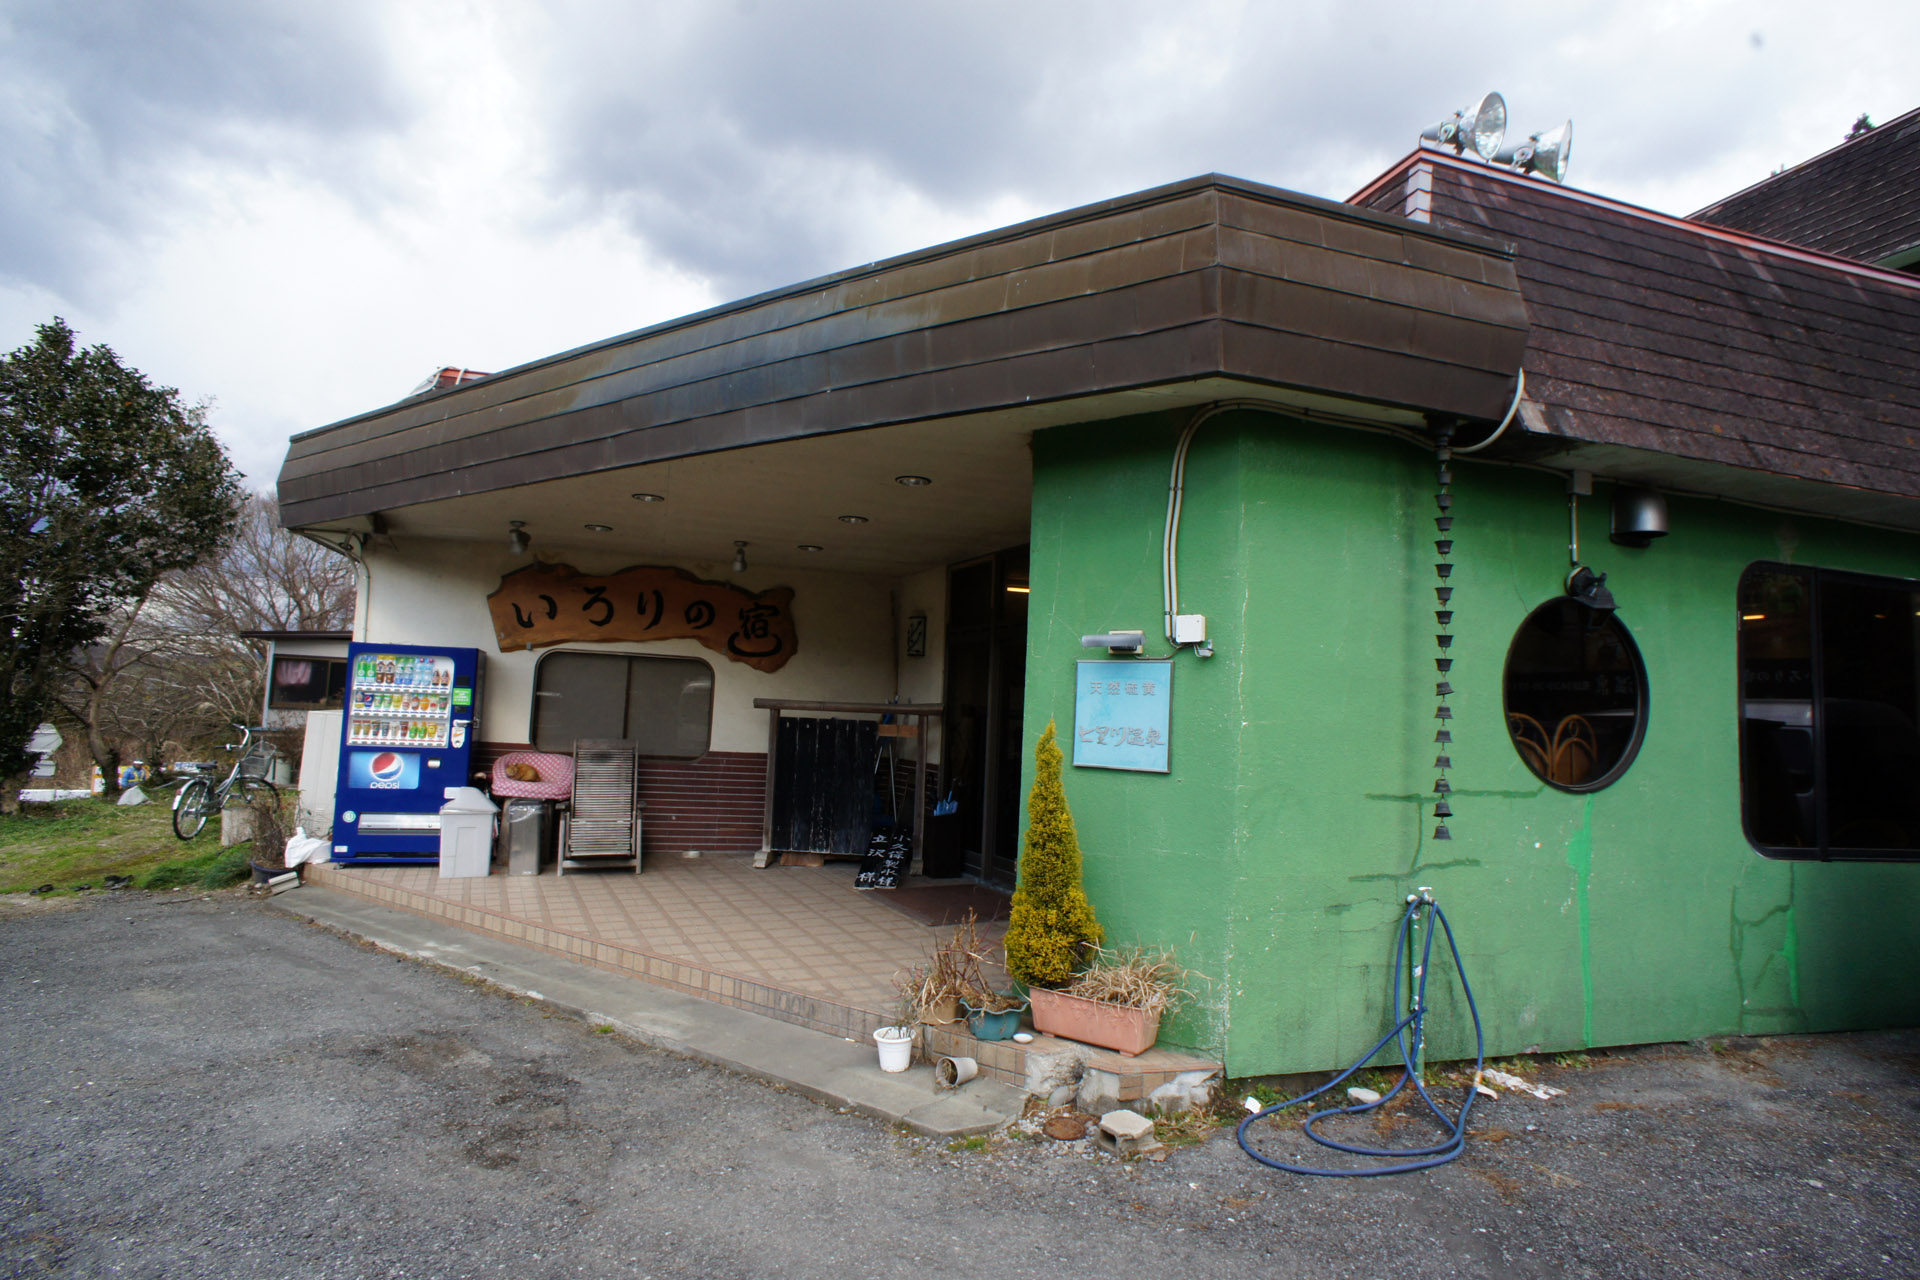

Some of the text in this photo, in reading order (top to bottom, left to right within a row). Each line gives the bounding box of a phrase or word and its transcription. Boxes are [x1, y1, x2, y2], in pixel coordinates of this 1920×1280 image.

[511, 585, 782, 642] いろりの宿
[1089, 680, 1157, 697] 天然硫黄
[369, 780, 401, 789] pepsi
